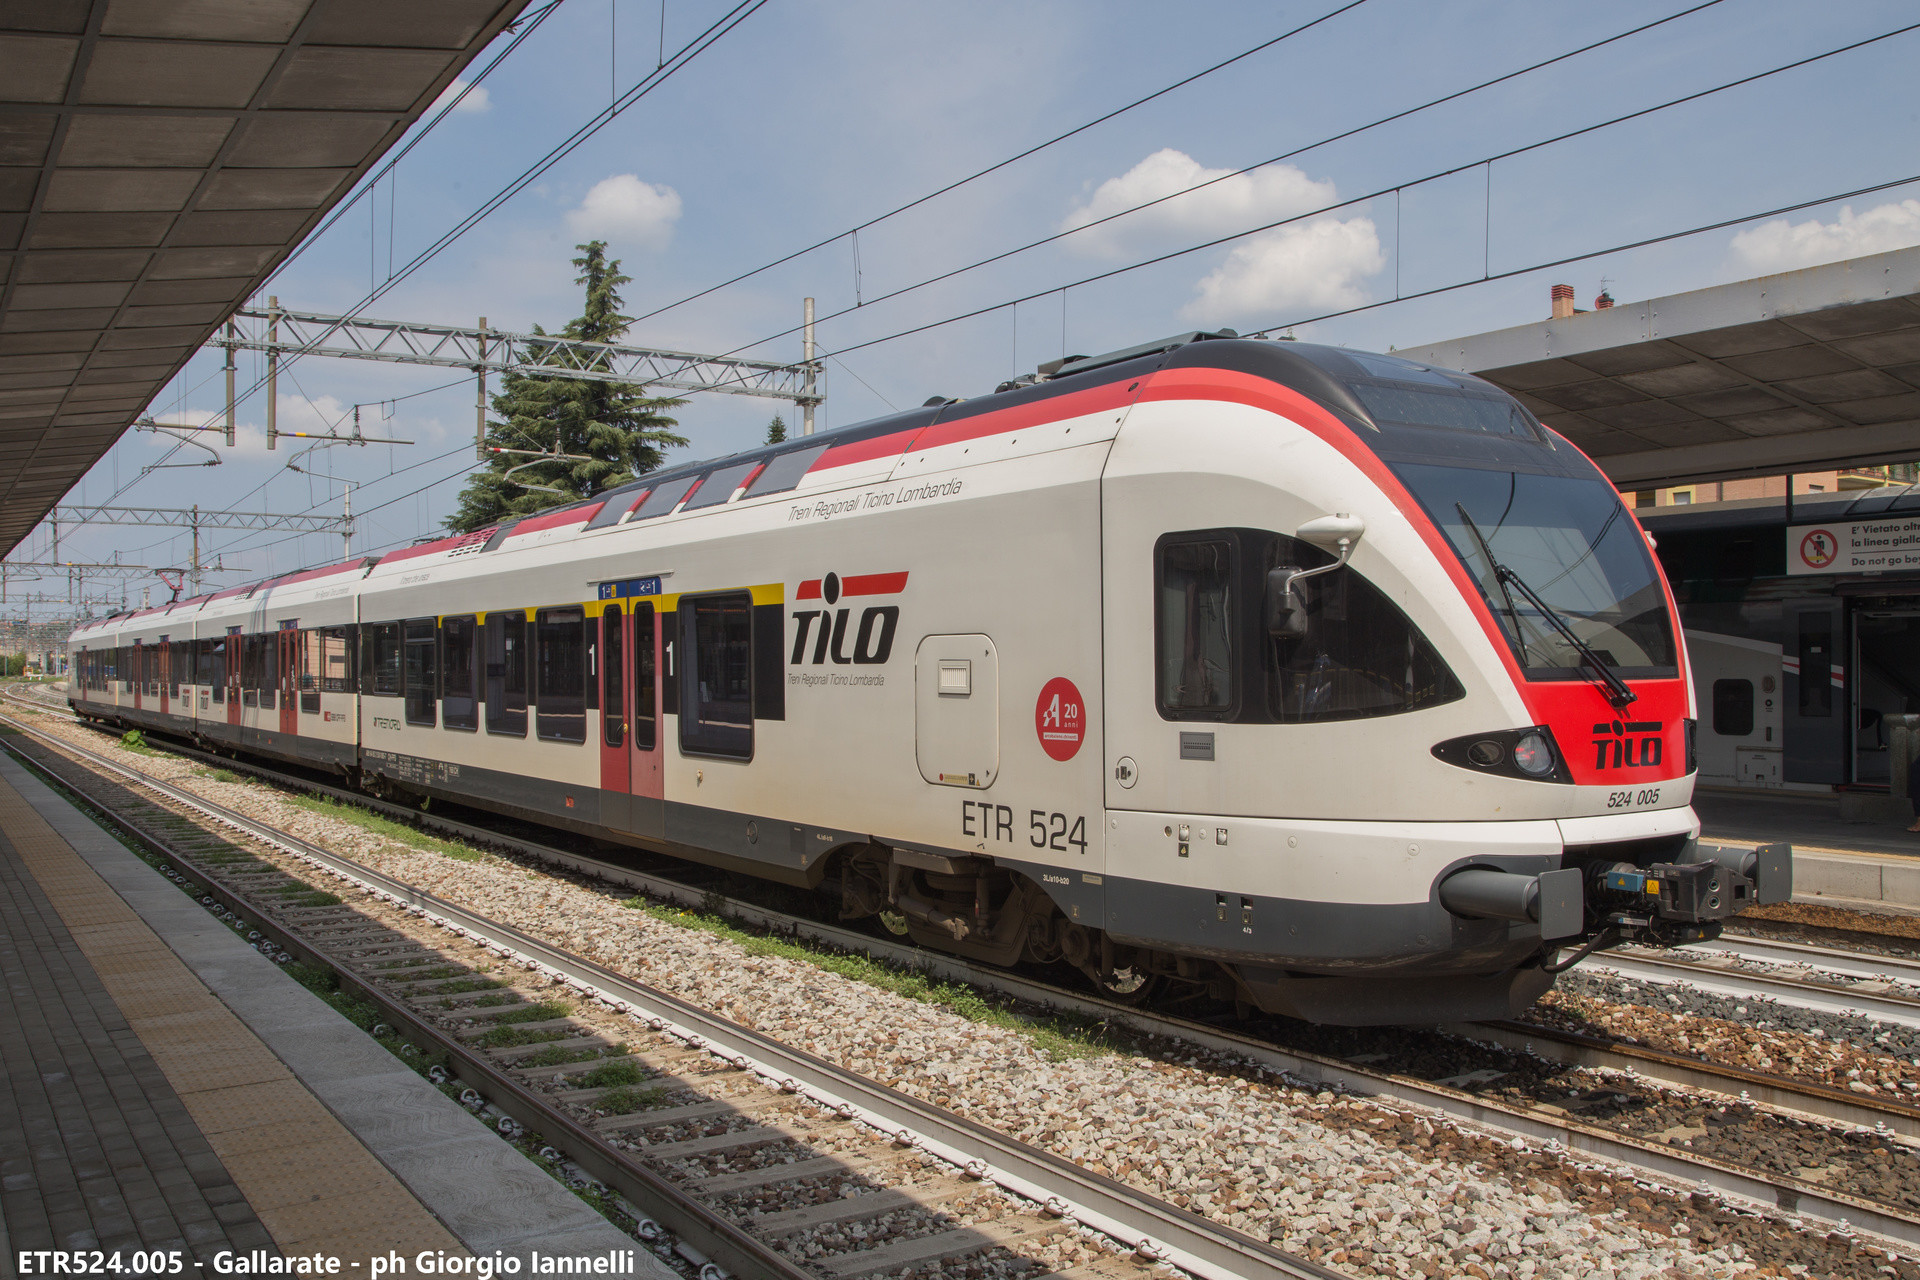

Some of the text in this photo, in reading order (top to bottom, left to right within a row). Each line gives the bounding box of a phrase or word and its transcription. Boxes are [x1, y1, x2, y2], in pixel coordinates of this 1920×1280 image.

[788, 477, 963, 521] Treni Regionali Ticino Lombardia
[1863, 525, 1900, 534] Vietato
[1851, 538, 1861, 547] la
[1864, 537, 1889, 547] linea
[1851, 558, 1866, 566] Do
[1869, 557, 1885, 566] not
[1888, 558, 1902, 567] go
[588, 643, 595, 676] 1
[666, 641, 674, 677] 1
[788, 673, 800, 685] Treni
[830, 673, 849, 686] Ticino
[849, 673, 885, 686] Lombardia
[1064, 703, 1078, 719] 20
[1607, 788, 1661, 808] 524 005
[962, 800, 1088, 855] ETR 524
